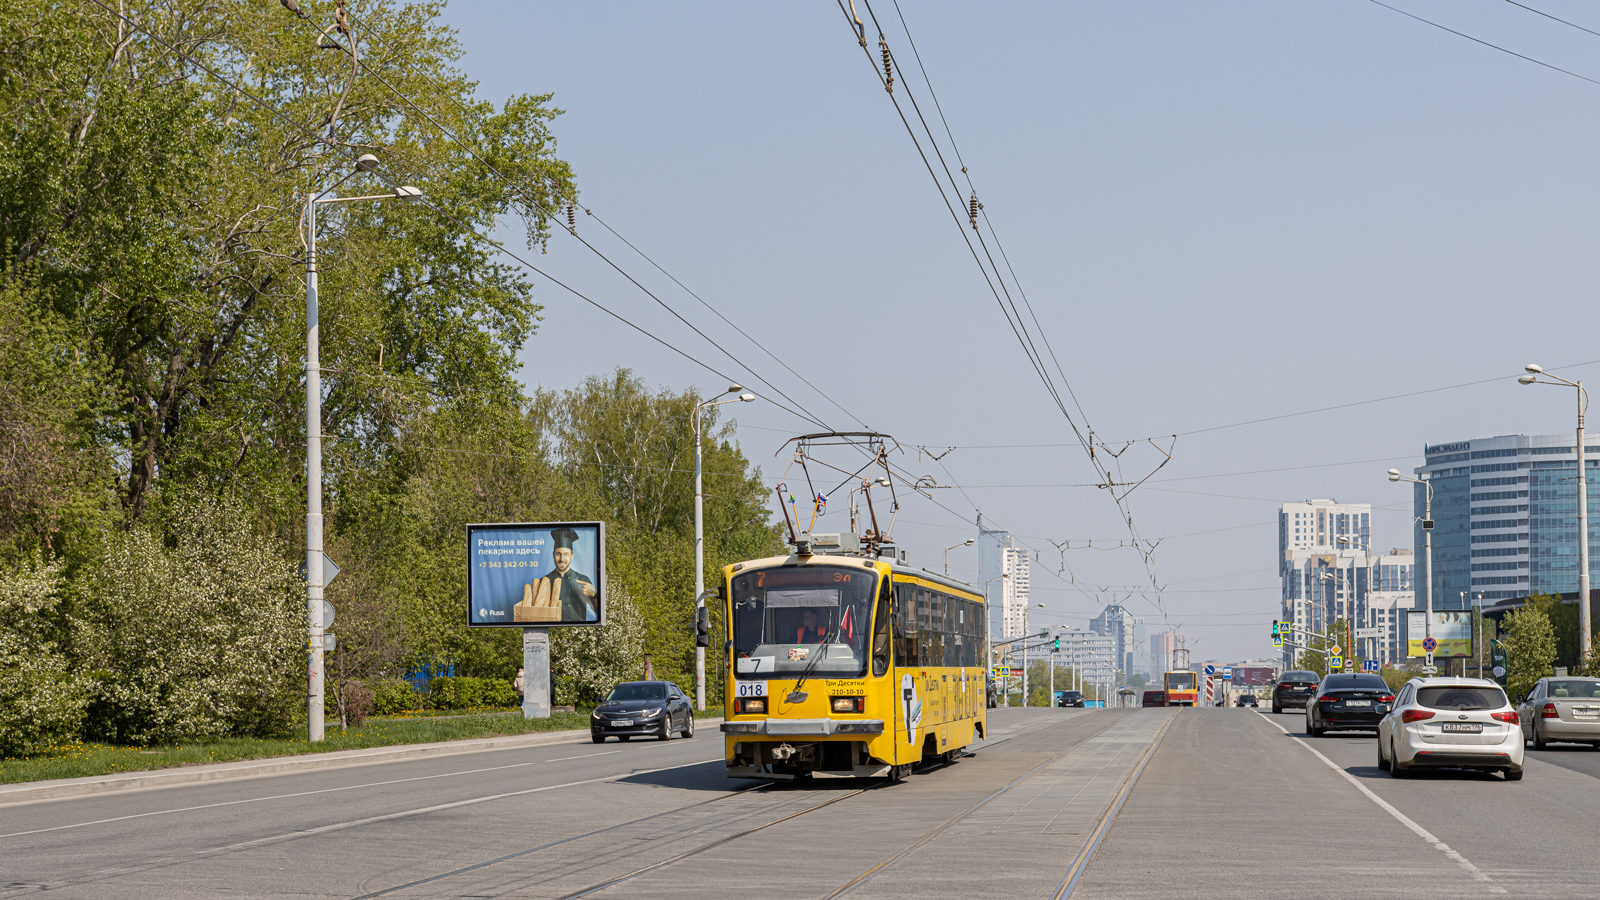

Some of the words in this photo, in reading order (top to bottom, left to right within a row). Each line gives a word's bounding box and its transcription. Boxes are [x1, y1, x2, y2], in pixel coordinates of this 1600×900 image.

[517, 538, 545, 546] вашей
[756, 571, 766, 587] 7
[751, 659, 761, 673] 7
[825, 680, 837, 688] Три
[837, 680, 865, 688] Десятки
[740, 685, 763, 696] 018
